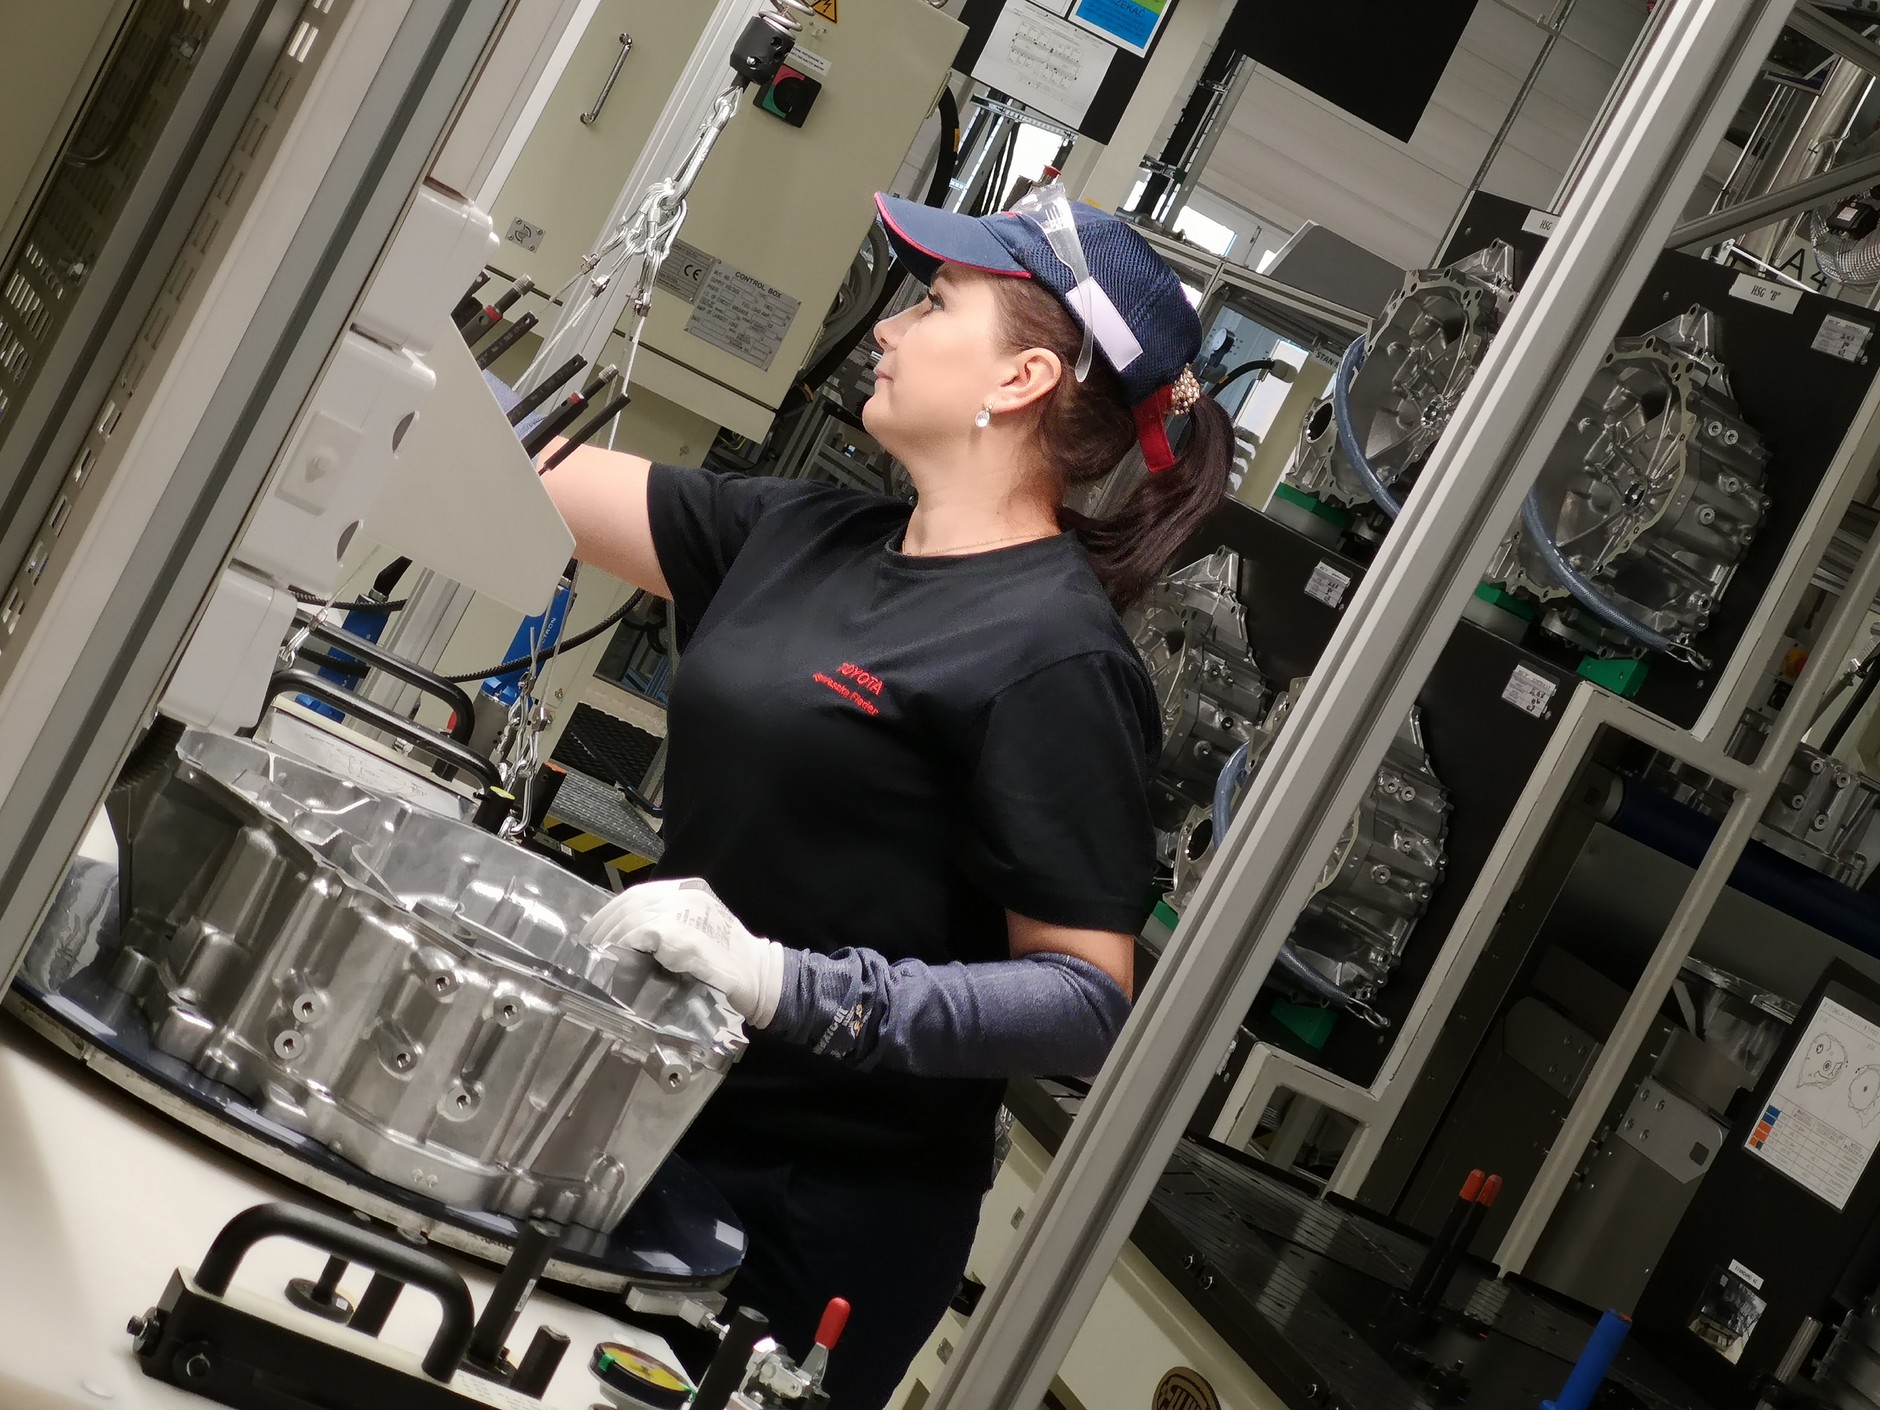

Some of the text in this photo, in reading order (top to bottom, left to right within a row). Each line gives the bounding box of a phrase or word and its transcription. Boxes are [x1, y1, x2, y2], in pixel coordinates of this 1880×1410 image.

[734, 271, 781, 298] CONTROL BOX
[1751, 285, 1766, 298] HSG
